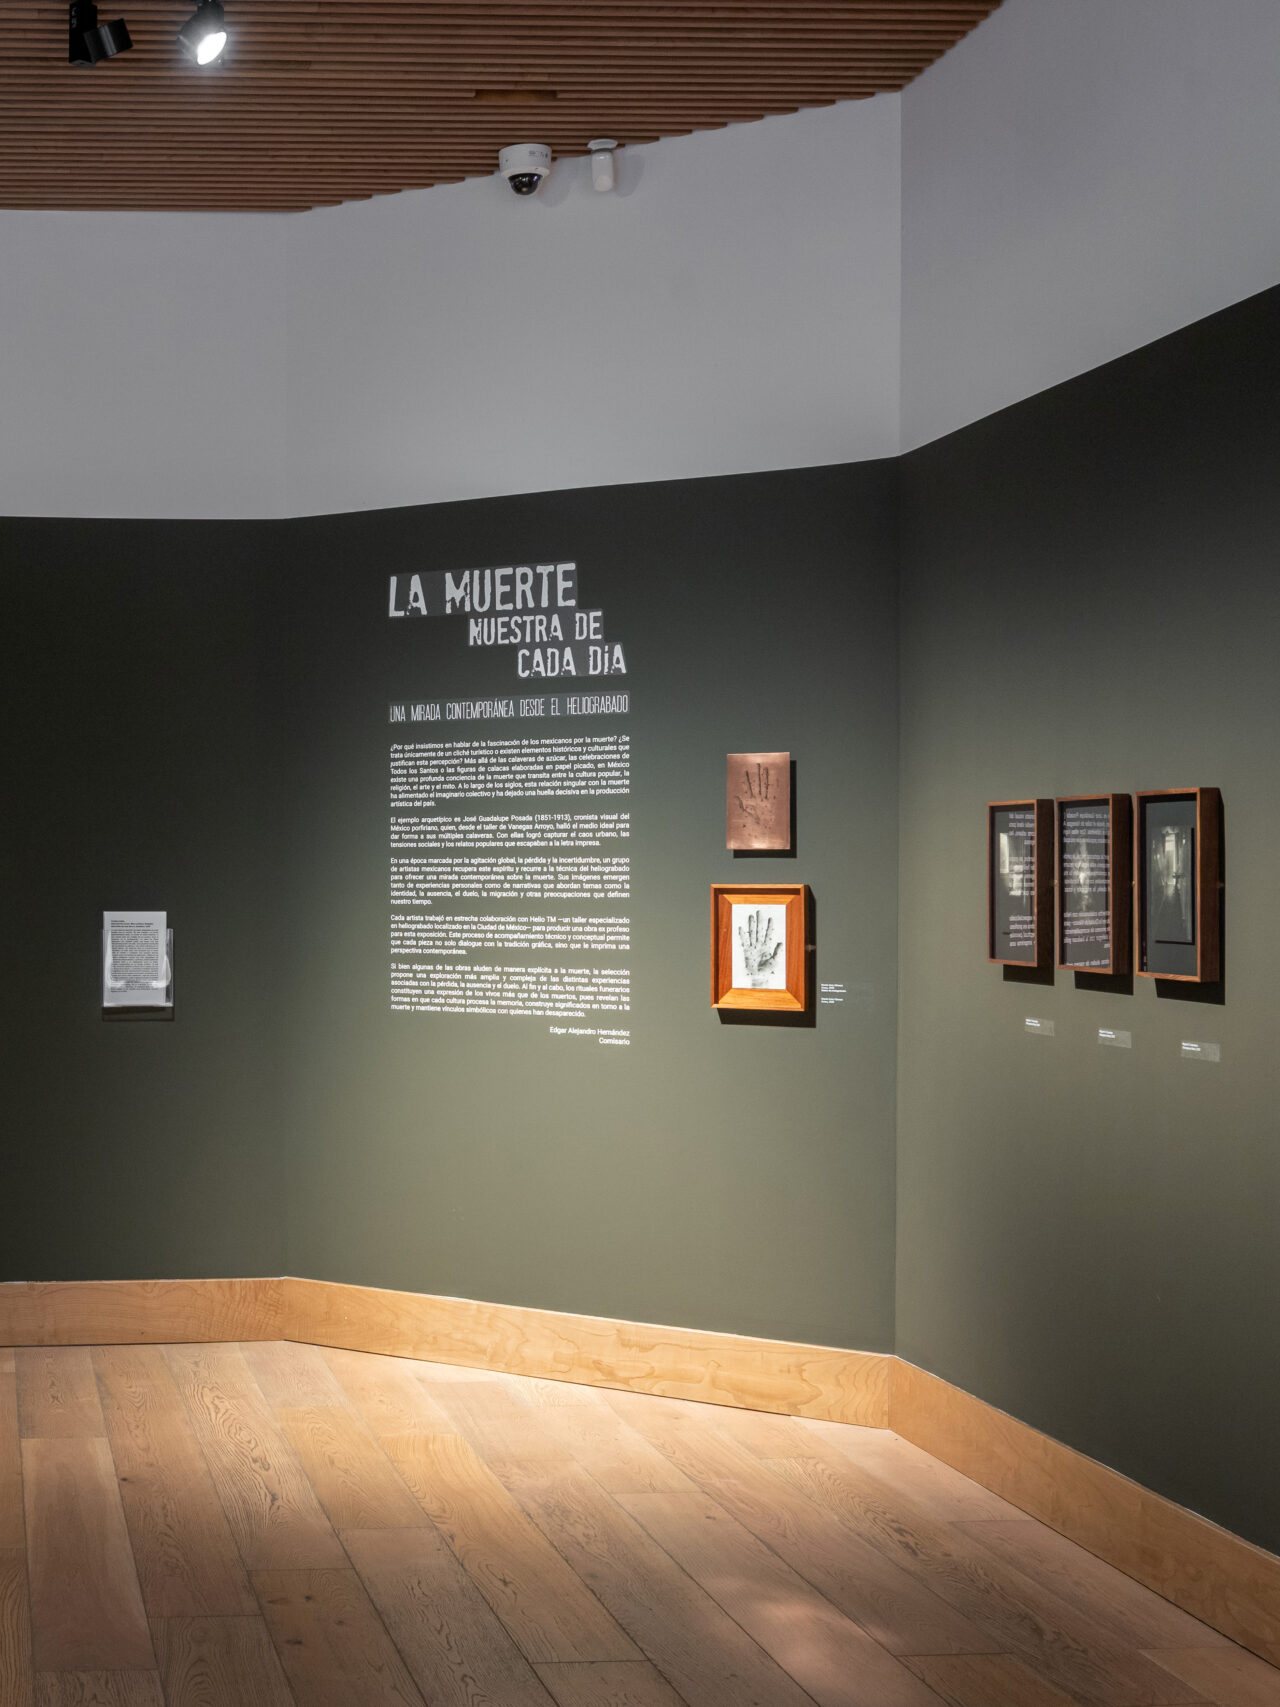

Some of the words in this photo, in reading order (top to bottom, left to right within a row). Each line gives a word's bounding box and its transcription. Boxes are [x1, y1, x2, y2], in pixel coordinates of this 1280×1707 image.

[389, 574, 428, 616] LA
[445, 562, 576, 614] MUERTE
[469, 614, 563, 646] NUESTRA
[575, 611, 602, 640] DE
[518, 646, 576, 678] CADA
[390, 705, 406, 722] UNA
[411, 704, 440, 721] MIRADA
[446, 698, 514, 720] CONTEMPORÁNEA
[520, 698, 544, 716] DESDE
[551, 698, 560, 716] EL
[567, 694, 628, 715] HELIOGRABADO
